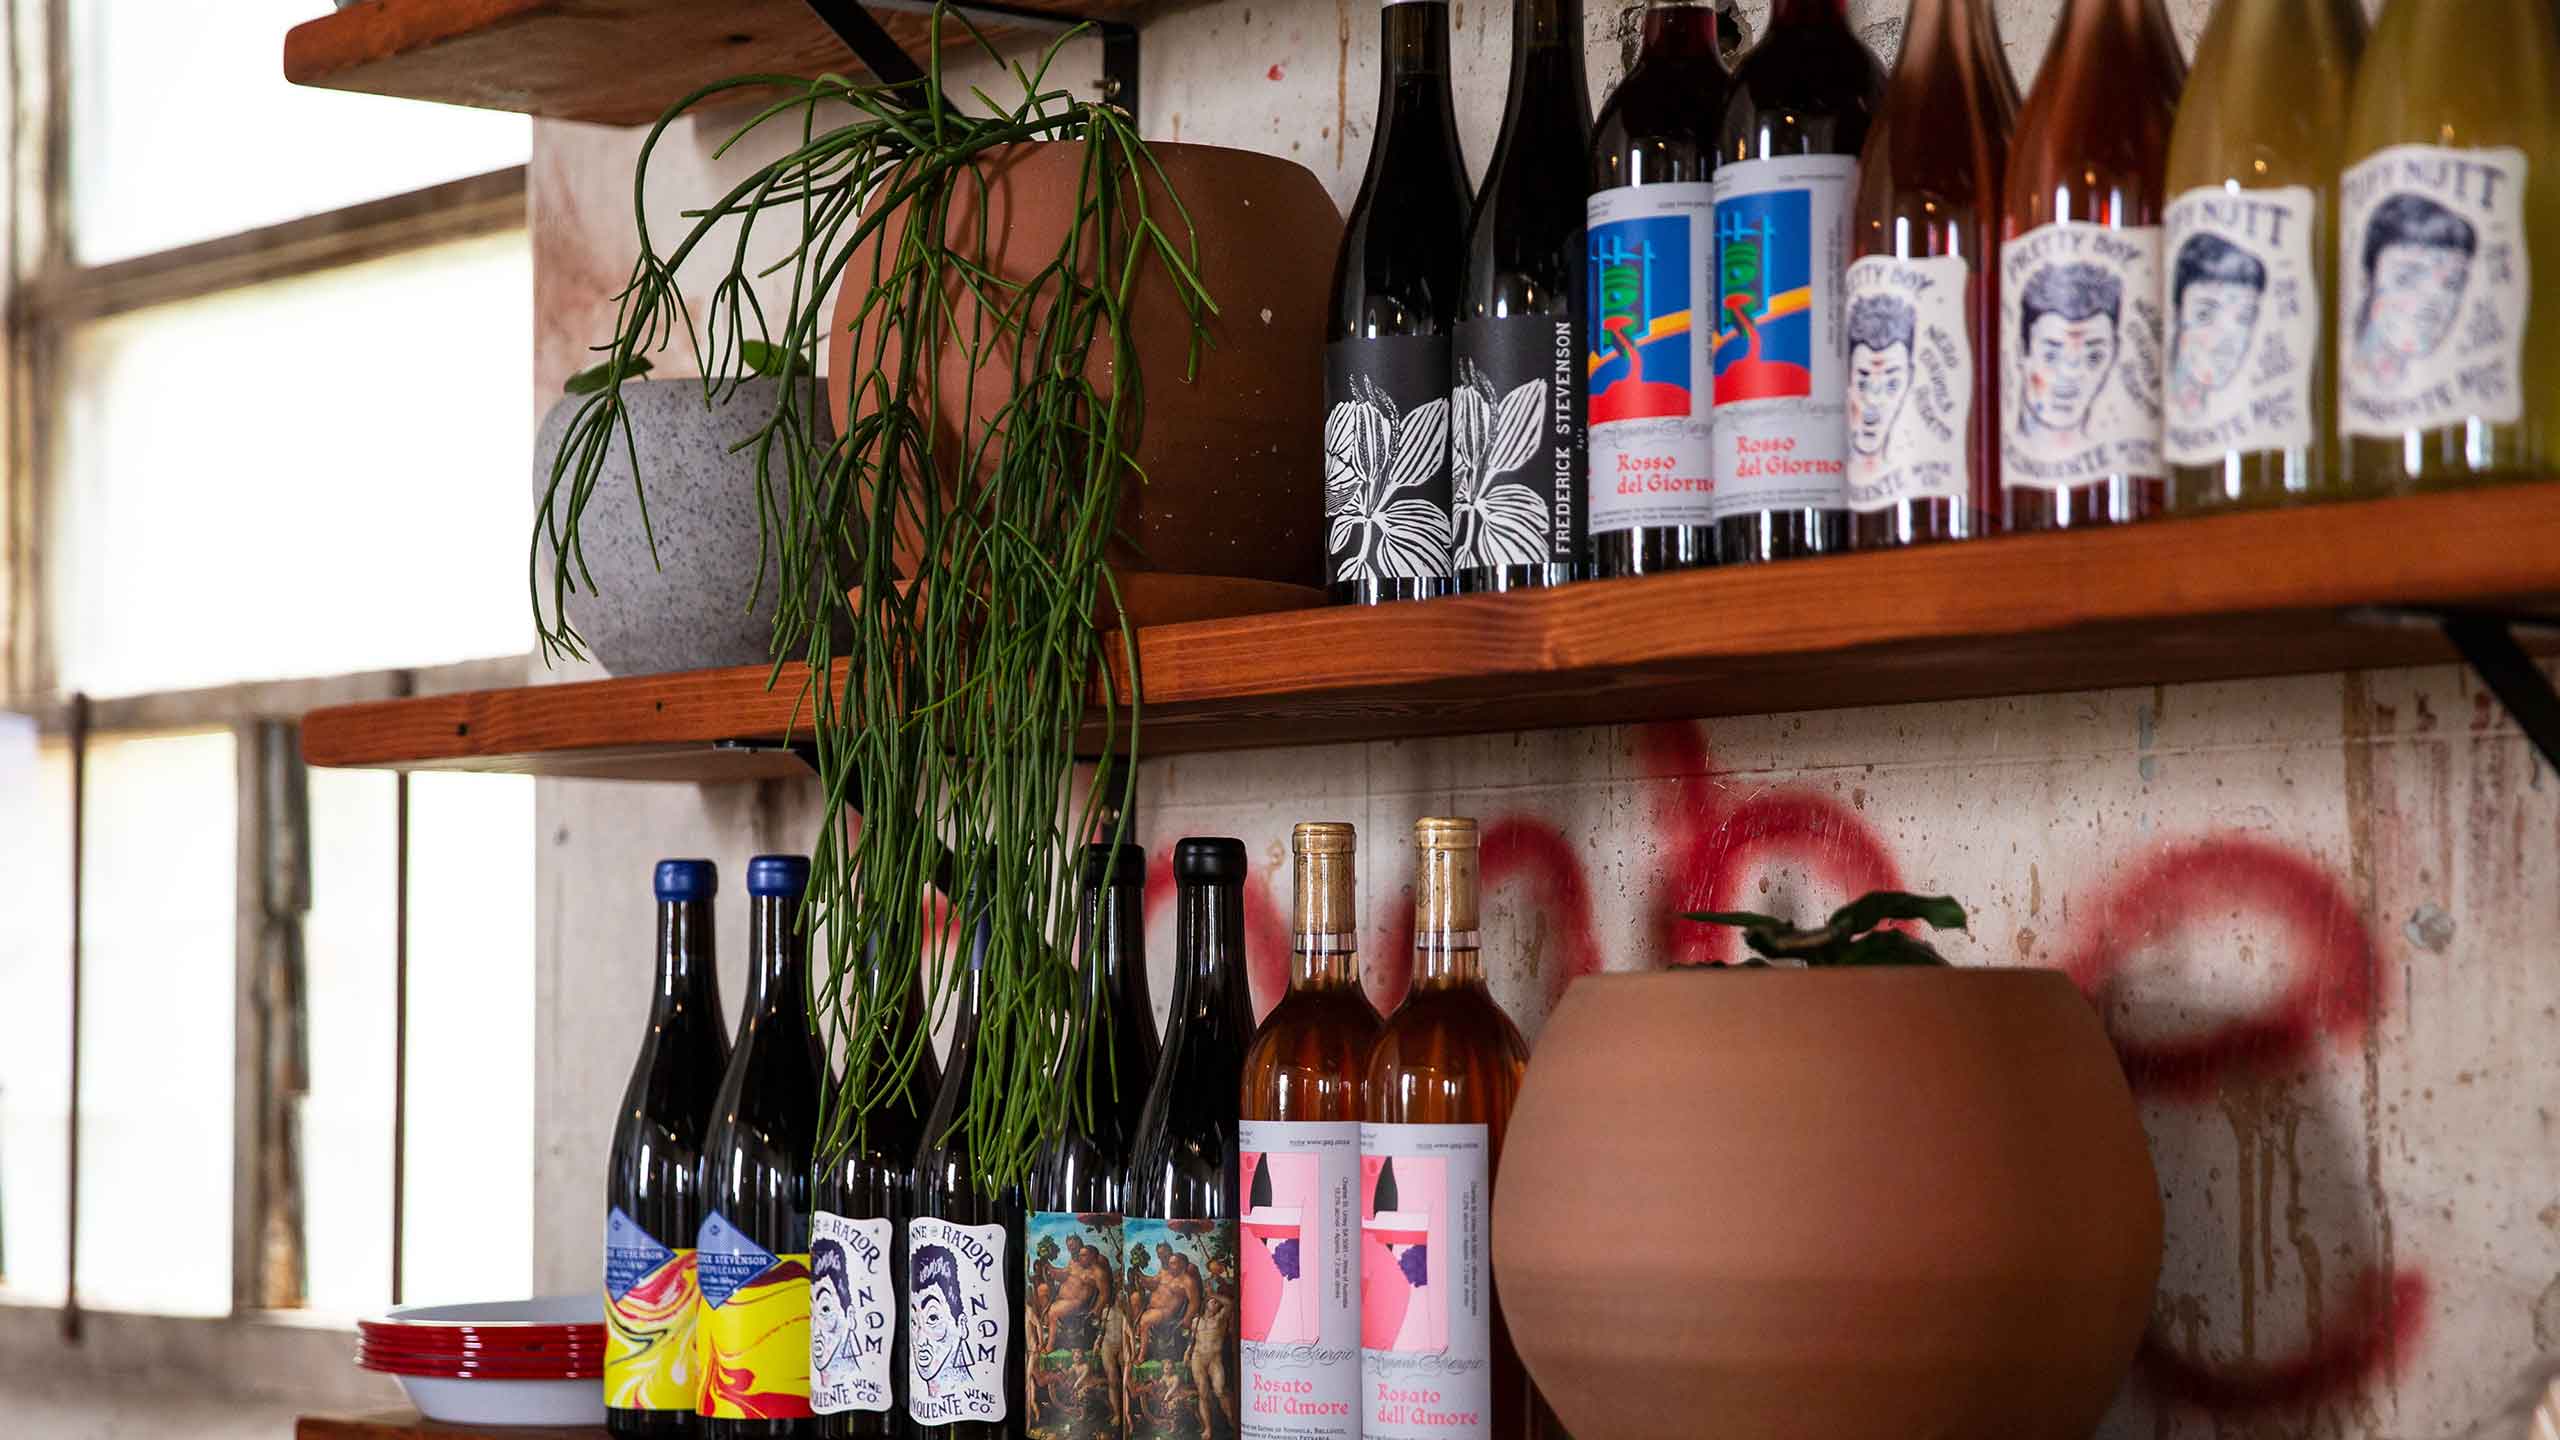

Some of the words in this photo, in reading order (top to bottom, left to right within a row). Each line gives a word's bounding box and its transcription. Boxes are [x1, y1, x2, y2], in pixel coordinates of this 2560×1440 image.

[1555, 321, 1571, 434] STEVENSON
[1736, 435, 1797, 454] Rosso
[1617, 453, 1677, 473] Rosso
[1736, 456, 1761, 478] del
[1764, 455, 1843, 477] Giorno
[1617, 474, 1643, 495] del
[1555, 447, 1571, 554] FREDERICK
[833, 1219, 881, 1275] RAZOR
[942, 1225, 995, 1282] RAZOR
[714, 1255, 767, 1266] STEVENSON
[852, 1378, 883, 1394] WINE
[1252, 1372, 1313, 1393] Rosato
[963, 1388, 997, 1405] WINE
[1377, 1382, 1441, 1405] Rosato
